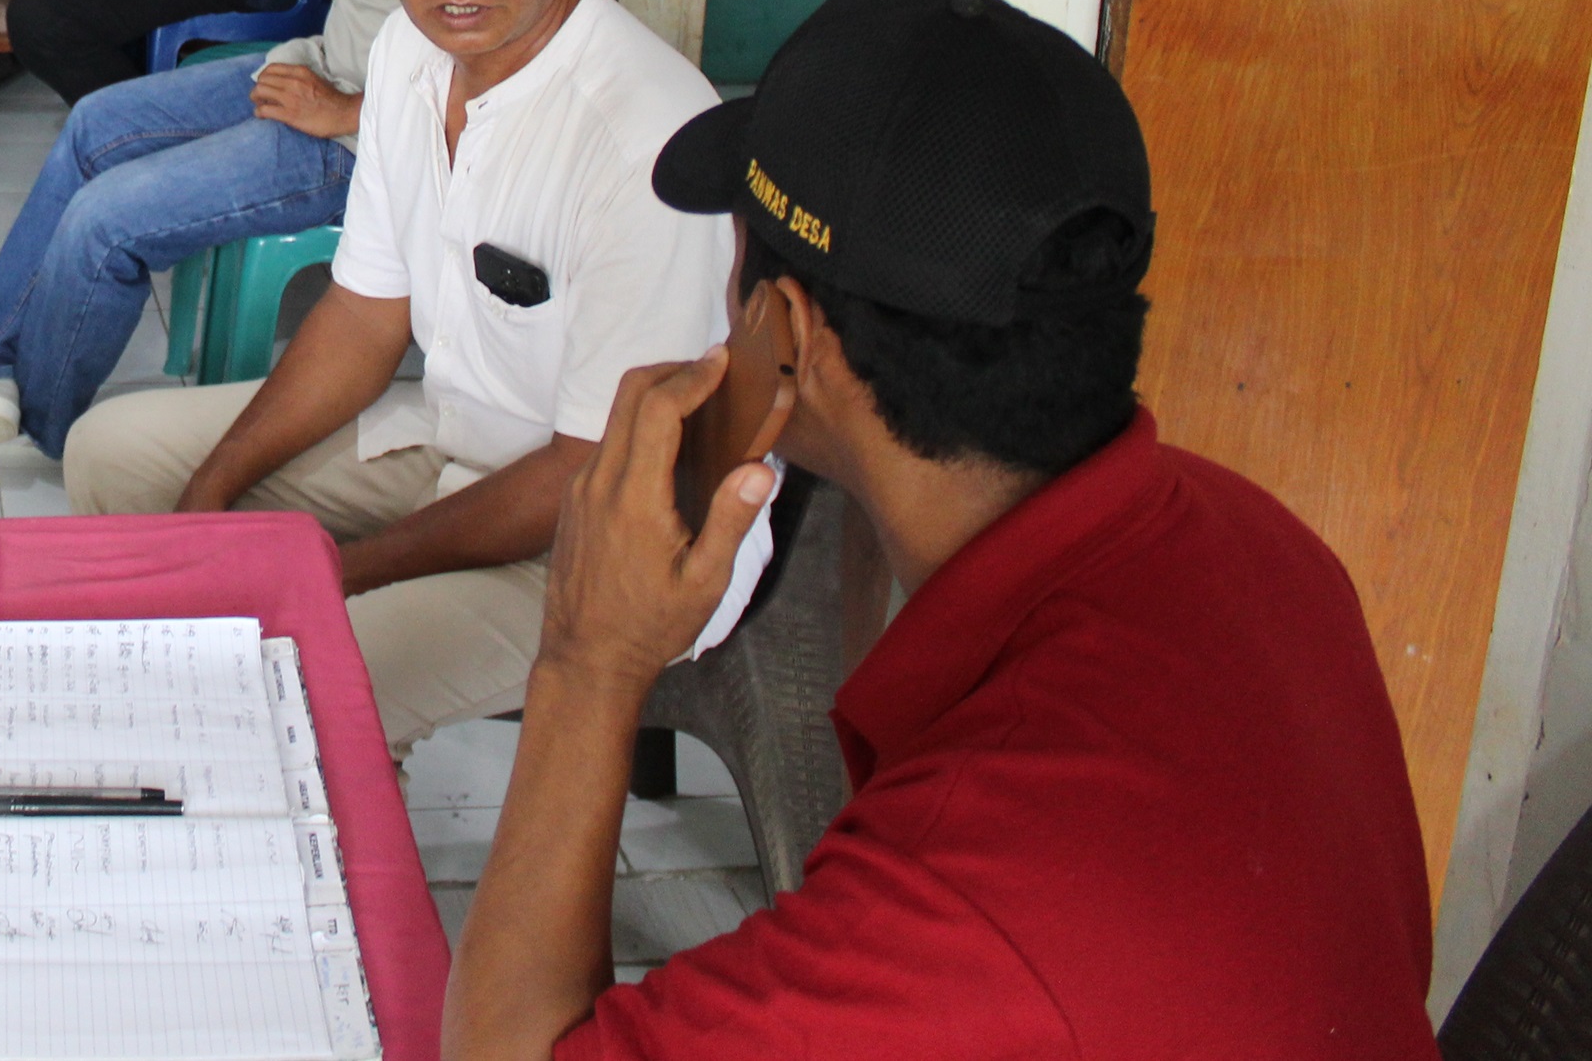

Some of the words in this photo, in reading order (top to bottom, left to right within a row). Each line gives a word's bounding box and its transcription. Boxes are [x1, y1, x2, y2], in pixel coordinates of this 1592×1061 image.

[746, 158, 789, 221] PANWAS
[789, 204, 830, 254] DESA
[298, 780, 310, 810] JABATAN
[309, 832, 324, 880] KEPERLUAN
[328, 918, 338, 935] TTD
